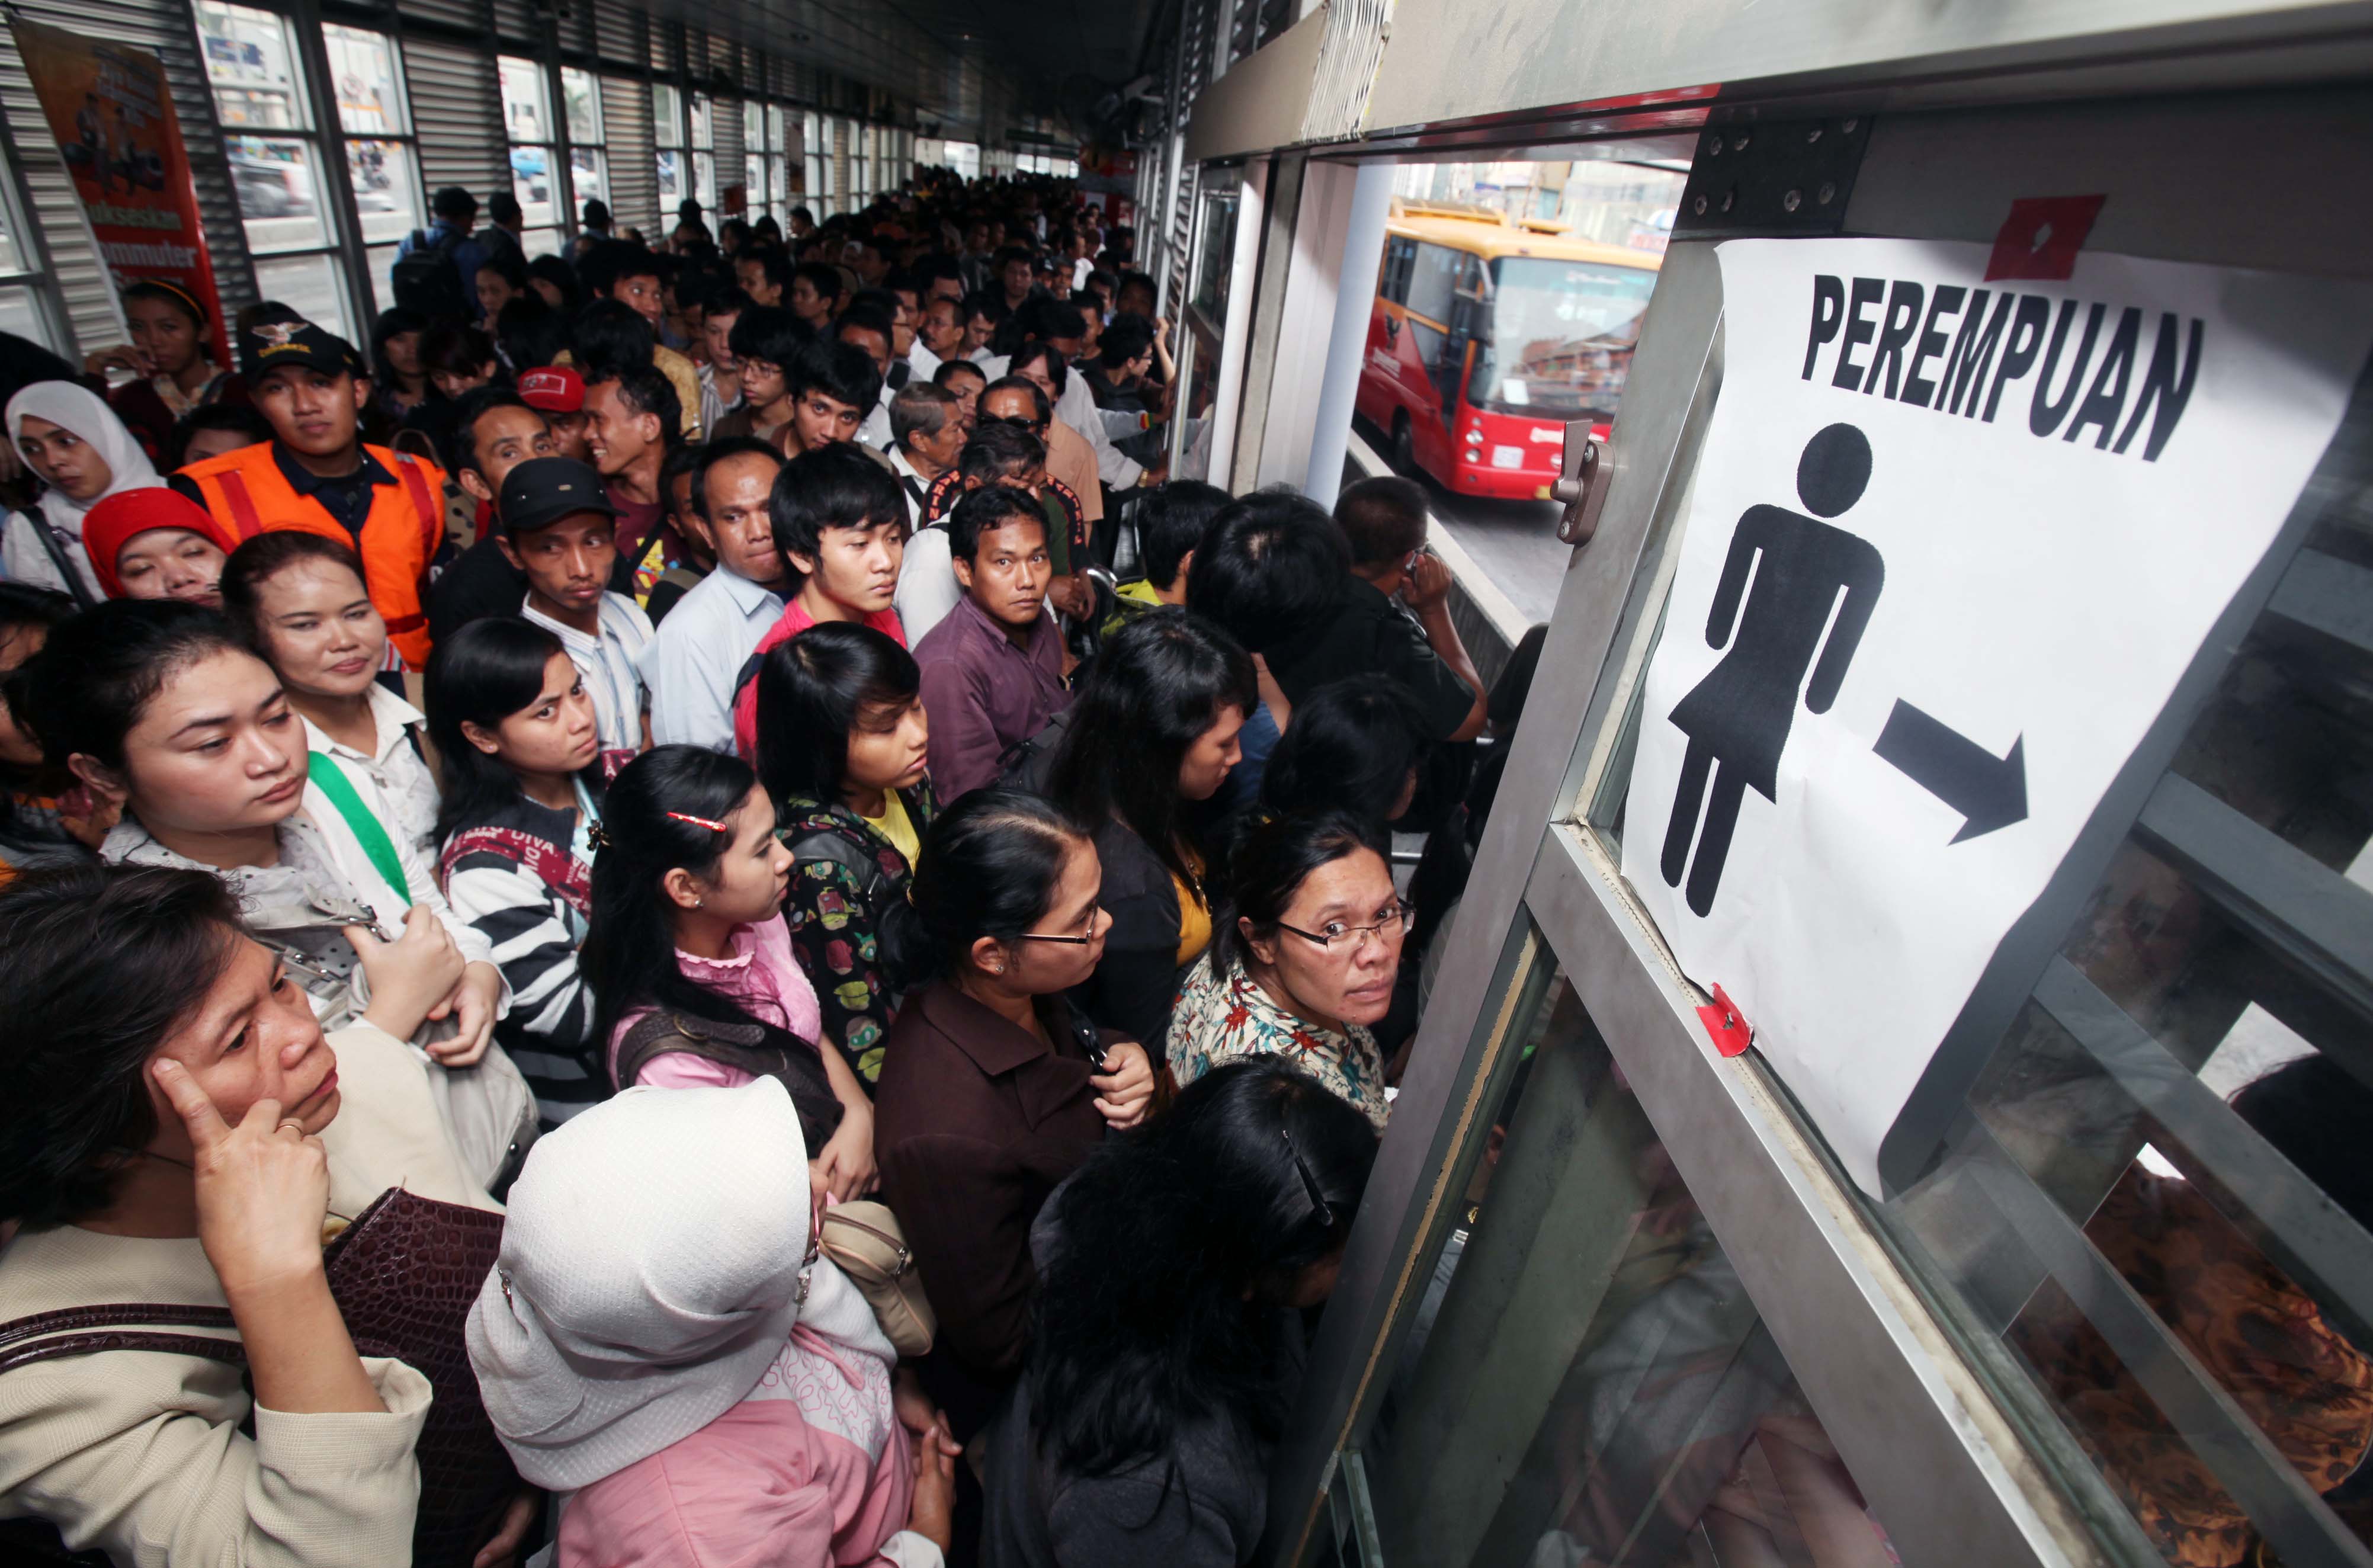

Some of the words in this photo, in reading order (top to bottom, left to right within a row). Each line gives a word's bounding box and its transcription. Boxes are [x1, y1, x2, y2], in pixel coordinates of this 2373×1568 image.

[86, 200, 182, 230] ukseskan
[99, 239, 197, 268] ommuter
[1801, 274, 2204, 462] PEREMPUAN
